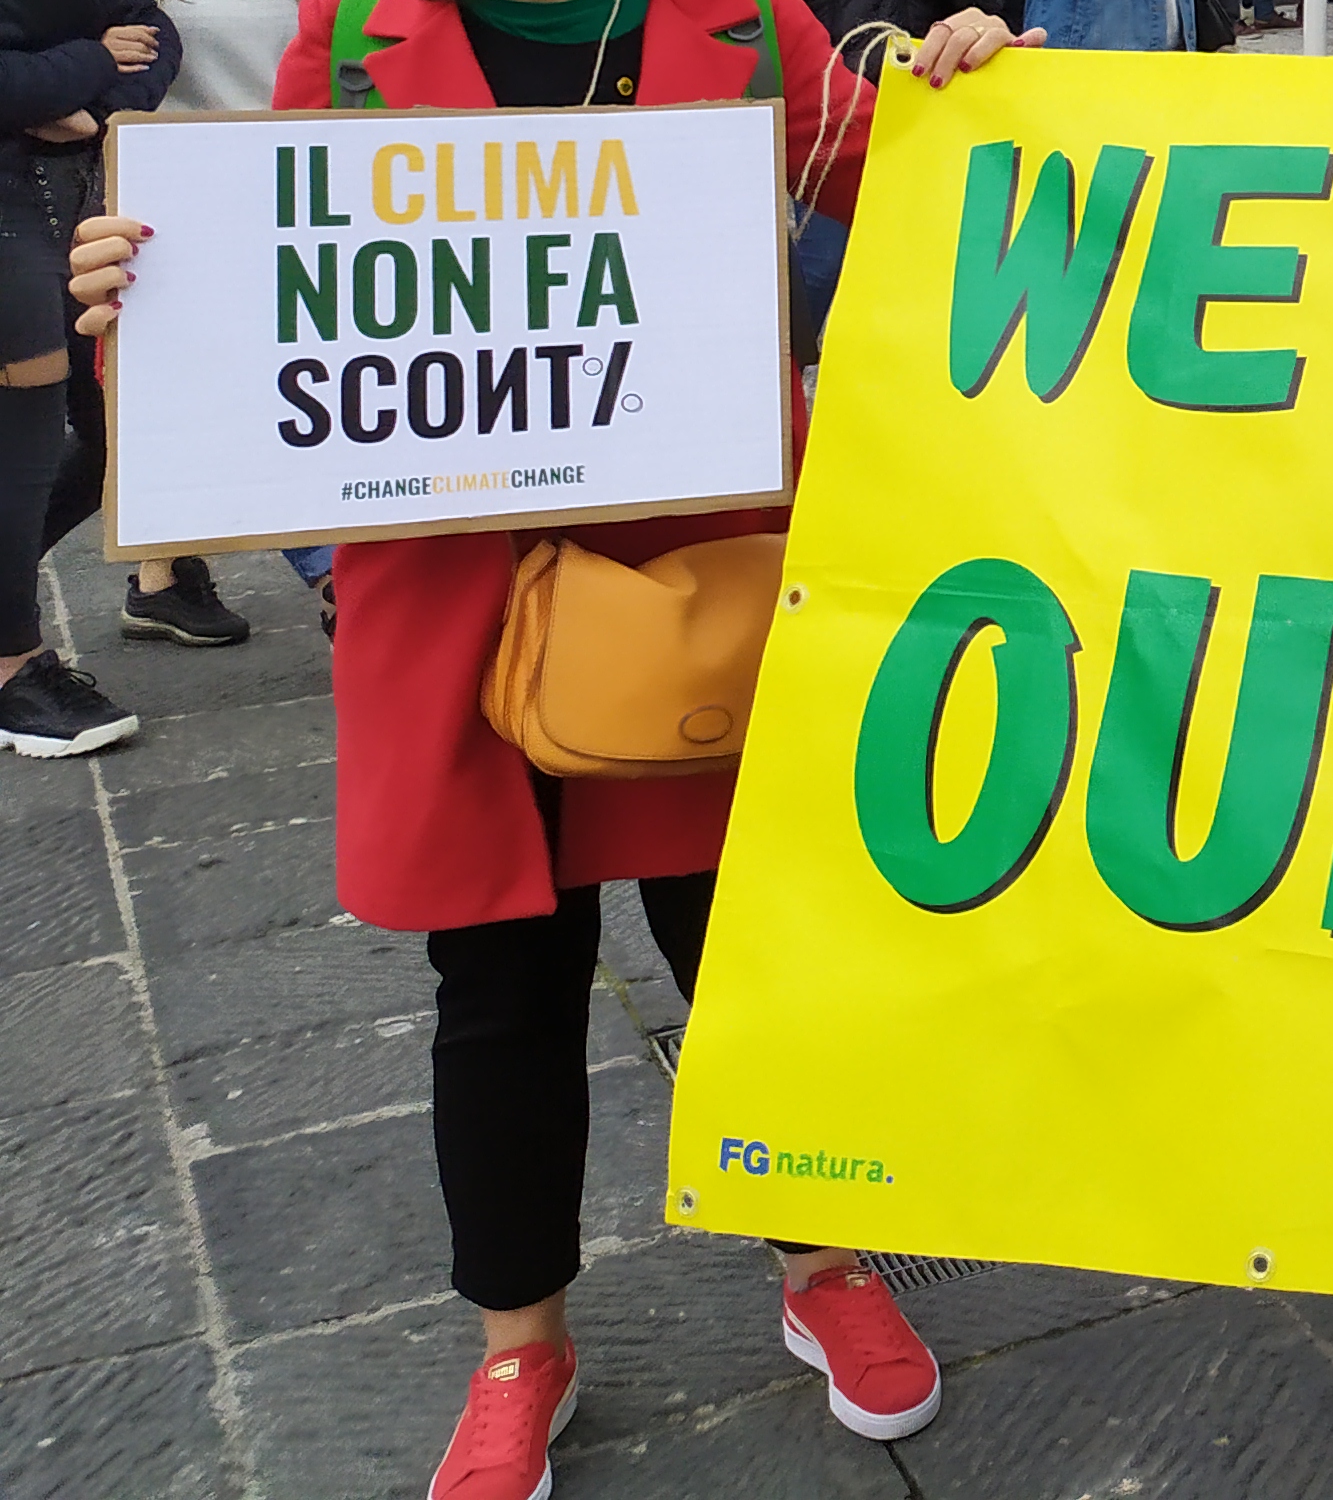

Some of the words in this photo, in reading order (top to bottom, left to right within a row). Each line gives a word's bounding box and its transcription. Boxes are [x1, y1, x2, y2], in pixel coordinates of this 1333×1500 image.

[274, 145, 352, 229] IL
[370, 138, 641, 227] CLIMA
[275, 235, 492, 345] NON
[525, 231, 640, 332] FA
[340, 465, 586, 501] #CHANGECLIMATECHANGE
[718, 1136, 770, 1177] FG
